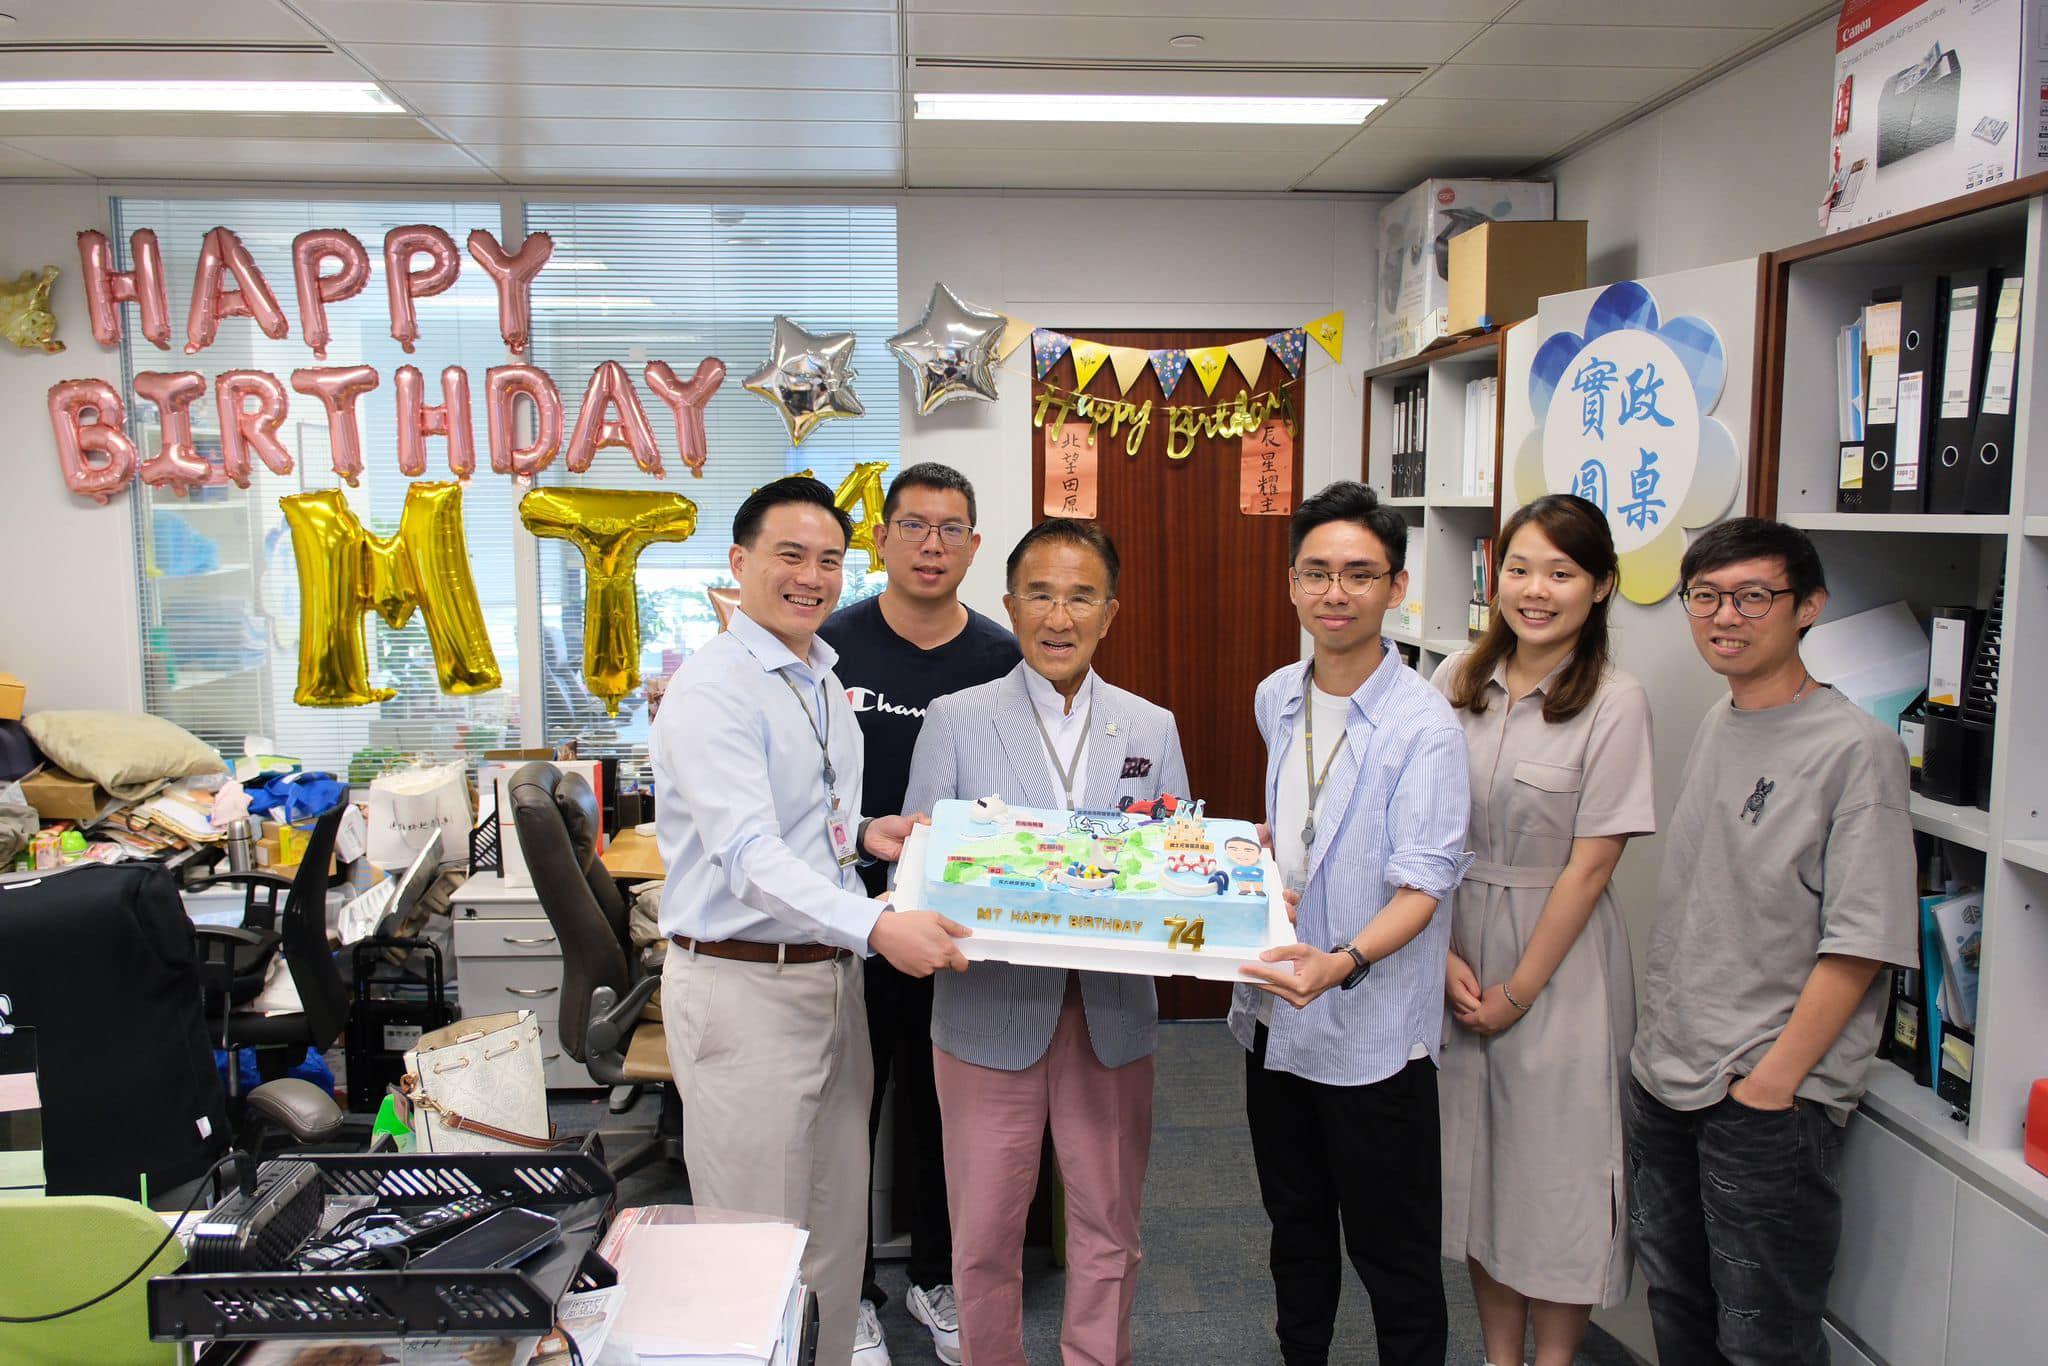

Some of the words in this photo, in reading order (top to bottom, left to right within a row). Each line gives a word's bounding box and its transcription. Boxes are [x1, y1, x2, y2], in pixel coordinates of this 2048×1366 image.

[1842, 17, 1871, 41] Canon
[77, 223, 556, 361] HAPPY
[47, 356, 727, 505] BIRTHDAY
[1033, 380, 1152, 456] Happy
[1165, 380, 1298, 460] Birthday
[1571, 357, 1675, 440] 實政
[1061, 432, 1081, 514] 北望田原
[279, 480, 698, 718] MT
[1011, 909, 1062, 929] HAPPY
[1069, 914, 1144, 934] BIRTHDAY
[1163, 914, 1205, 952] 74
